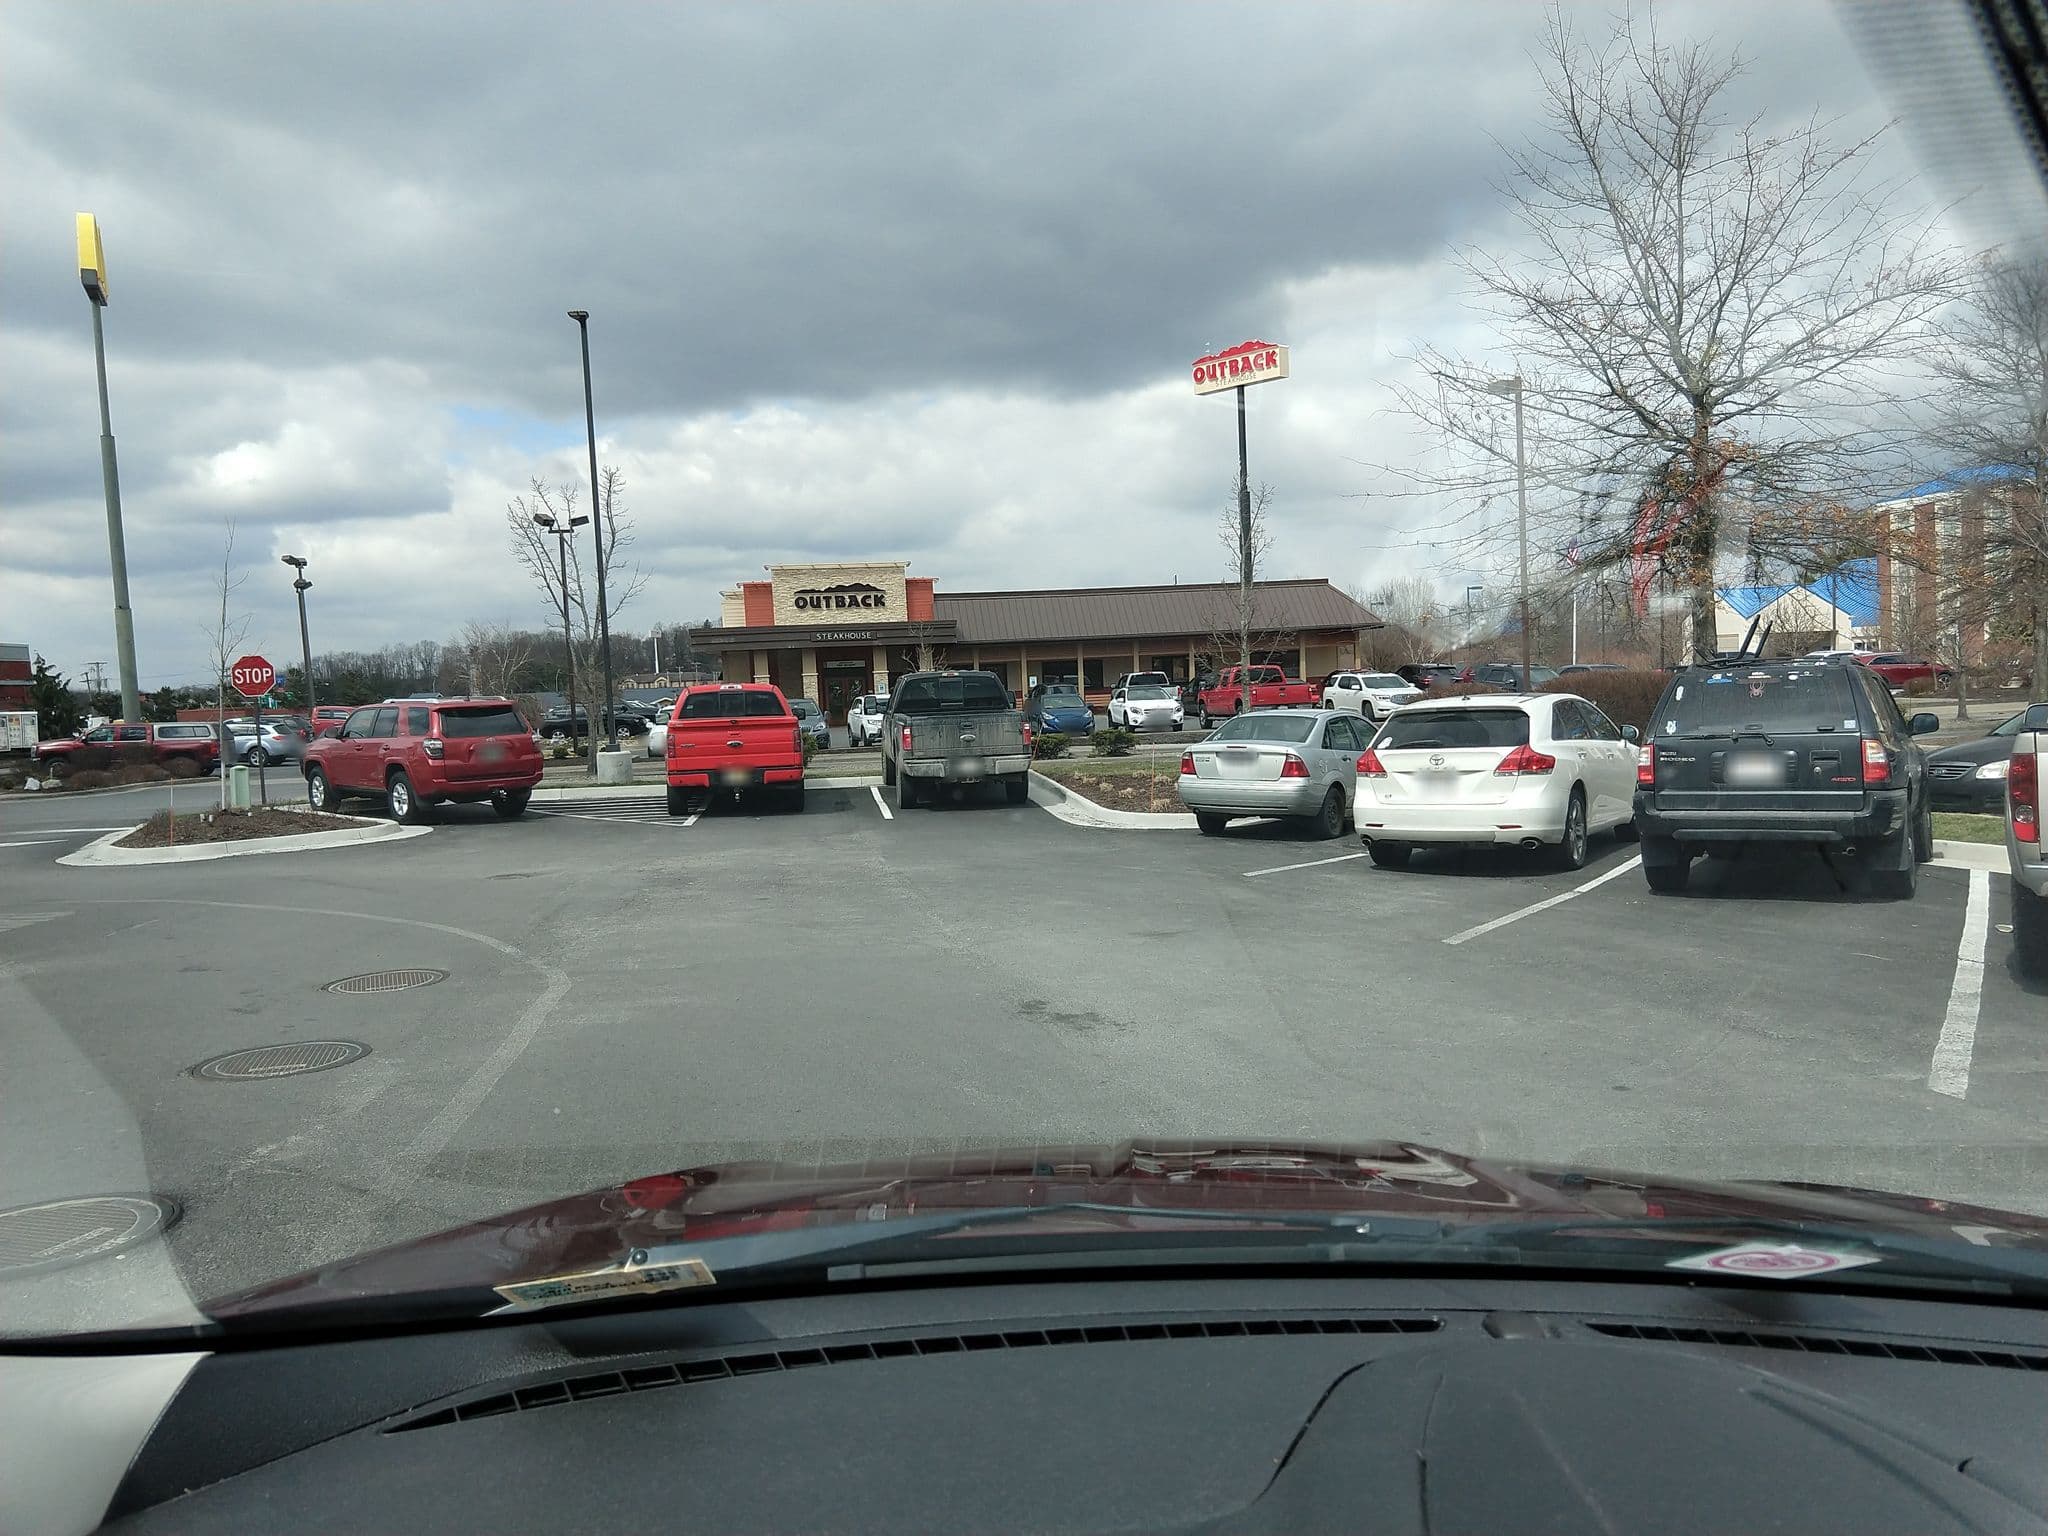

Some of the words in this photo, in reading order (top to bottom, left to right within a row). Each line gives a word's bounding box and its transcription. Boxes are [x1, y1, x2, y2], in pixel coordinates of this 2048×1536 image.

[1193, 350, 1278, 384] OUTBACK
[794, 594, 886, 609] OUTBACK
[816, 632, 872, 641] STEAKHOUSE
[234, 667, 272, 684] STOP
